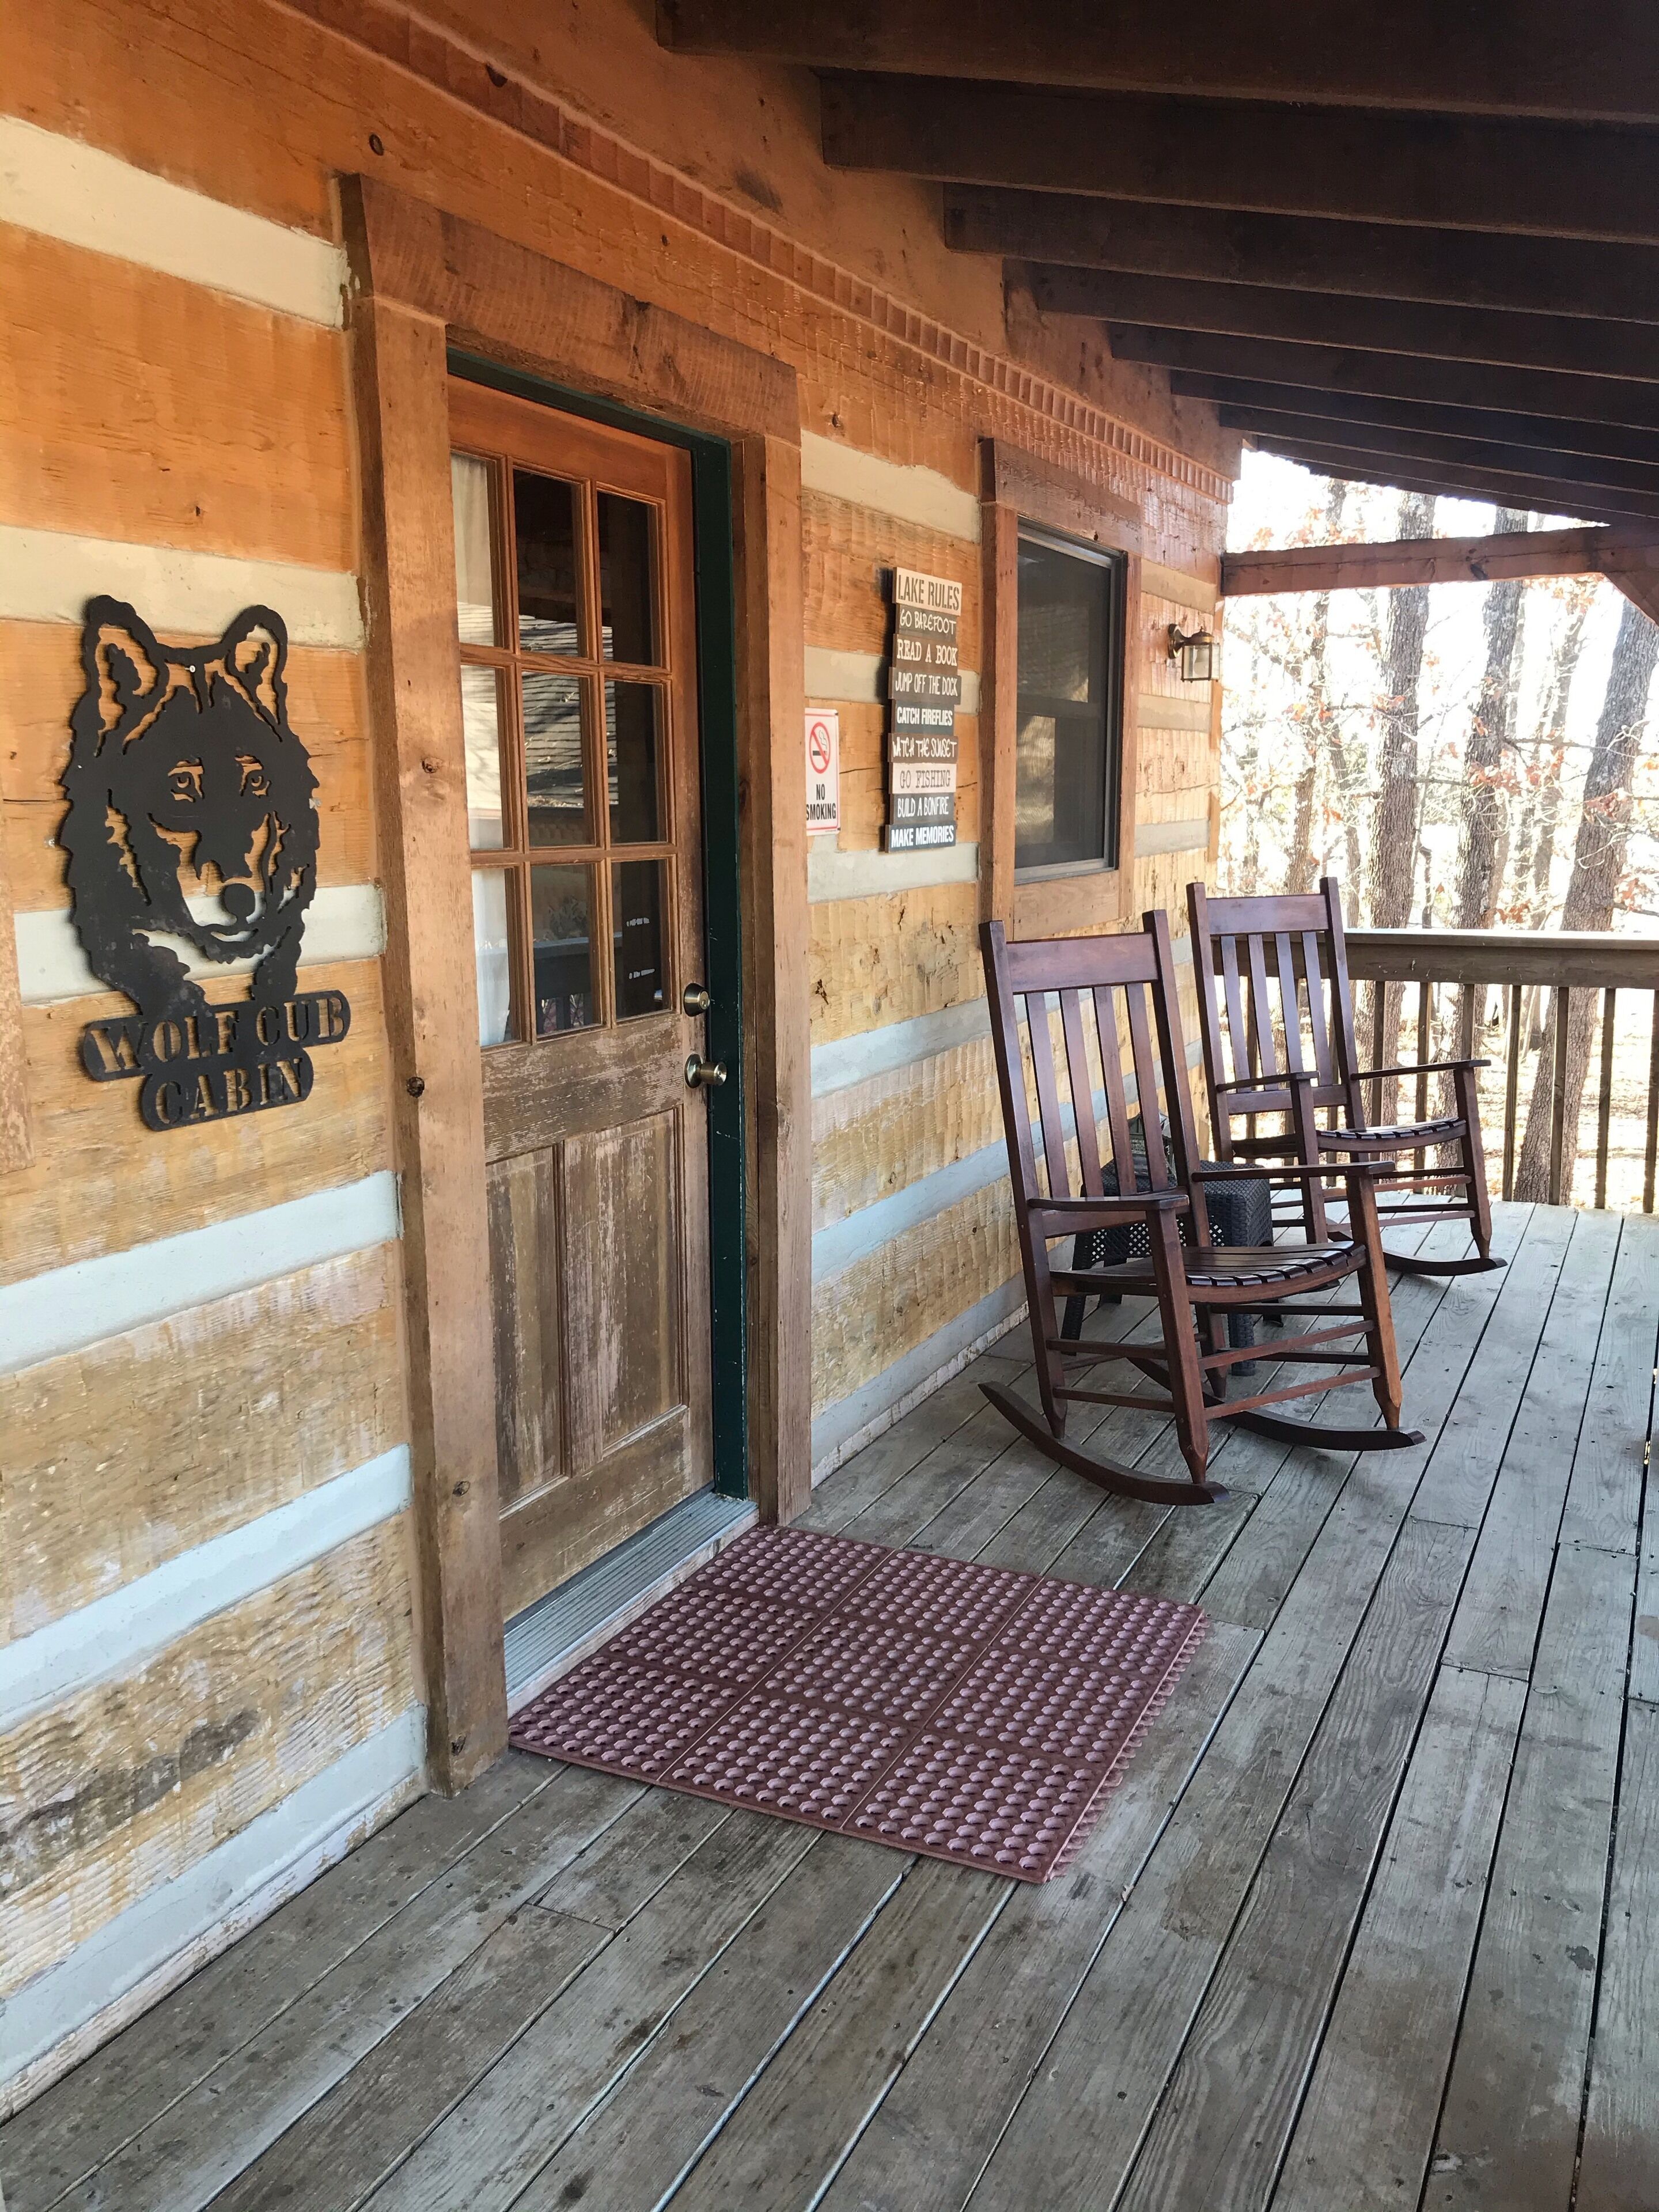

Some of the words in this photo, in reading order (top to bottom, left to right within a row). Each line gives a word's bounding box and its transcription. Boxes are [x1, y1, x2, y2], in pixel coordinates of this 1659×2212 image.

[898, 575, 924, 604] LAKE
[928, 582, 960, 611] RULES
[900, 609, 912, 627] GO
[914, 611, 956, 634] BAREFOOT
[897, 639, 922, 661] READ
[925, 644, 931, 662] A
[935, 645, 958, 666] BOOK
[895, 672, 912, 692] JUMP
[914, 673, 927, 693] OFF
[929, 675, 941, 695] THE
[942, 676, 958, 696] DOCK
[897, 706, 920, 725] CATCH
[922, 709, 953, 726] FIREFLIES
[892, 737, 914, 757] WATCH
[916, 738, 929, 757] THE
[931, 738, 957, 757] SUNSET
[900, 770, 911, 789] GO
[915, 770, 950, 789] FISHING
[816, 783, 825, 800] NO
[806, 802, 836, 821] SMOKING
[897, 798, 916, 818] BUILD
[917, 798, 922, 816] A
[924, 796, 949, 816] BONFIRE
[891, 828, 914, 848] MAKE
[916, 825, 954, 844] MEMORIES
[90, 1010, 239, 1074] WOLF
[256, 997, 344, 1046] CUB
[155, 1058, 304, 1124] CABIN
